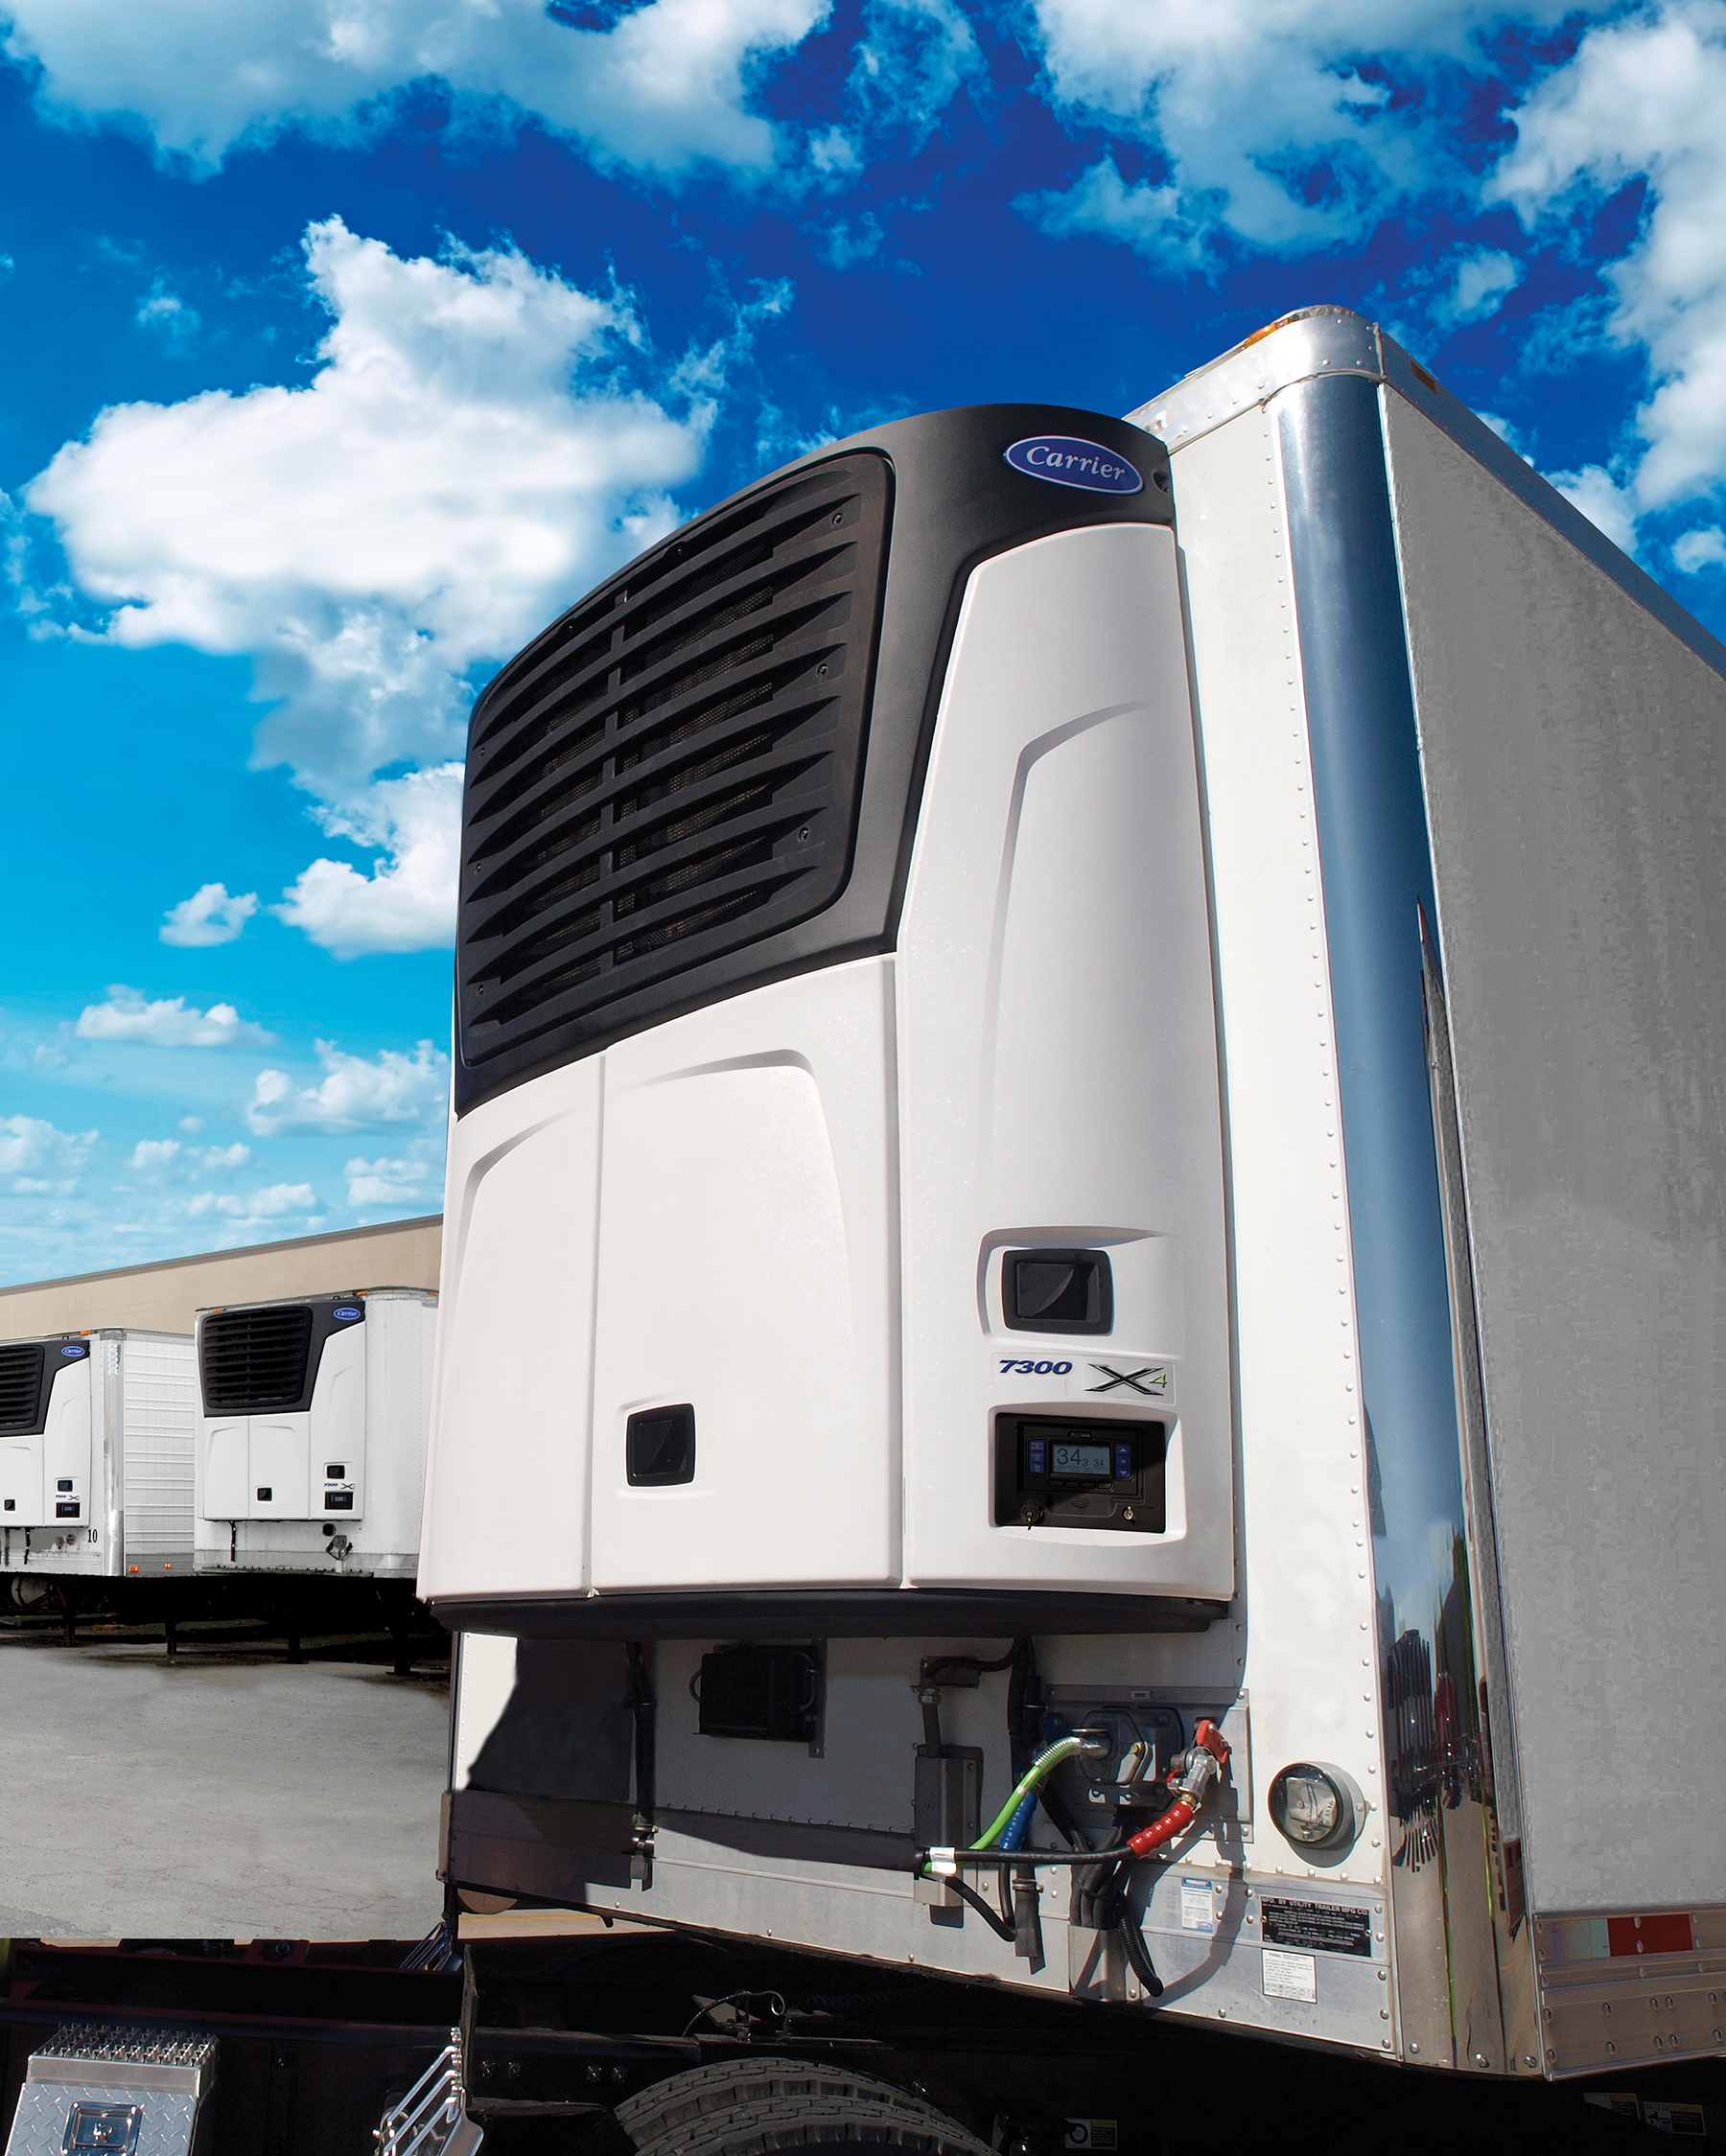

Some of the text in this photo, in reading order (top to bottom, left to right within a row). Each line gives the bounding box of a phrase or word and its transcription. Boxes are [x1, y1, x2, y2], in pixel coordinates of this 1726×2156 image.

[1026, 446, 1126, 479] Carrier
[999, 1359, 1073, 1375] 7300
[1093, 1458, 1104, 1467] 34
[88, 1529, 98, 1542] 10
[1315, 1903, 1341, 1912] TRAILER
